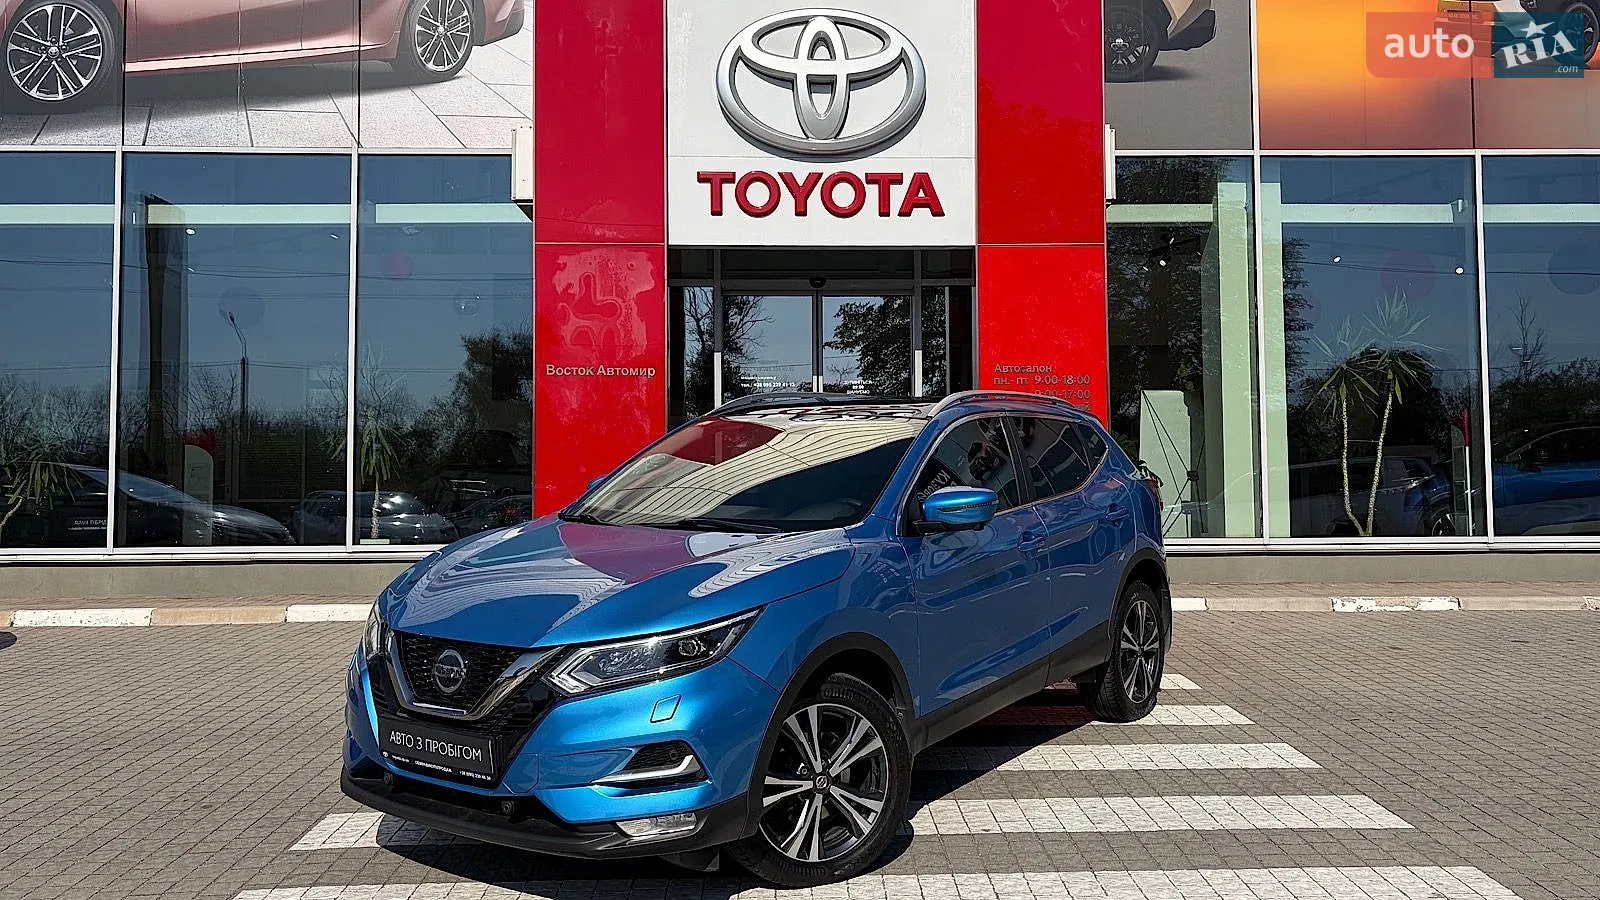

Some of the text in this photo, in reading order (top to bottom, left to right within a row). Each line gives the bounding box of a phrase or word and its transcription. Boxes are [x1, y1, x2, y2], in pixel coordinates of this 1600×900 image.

[697, 170, 946, 219] TOYOTA
[546, 364, 656, 378] Восток Автомир
[994, 363, 1052, 373] Автосалон
[389, 730, 414, 748] АВТО
[425, 738, 482, 762] ПРОБІГОМ
